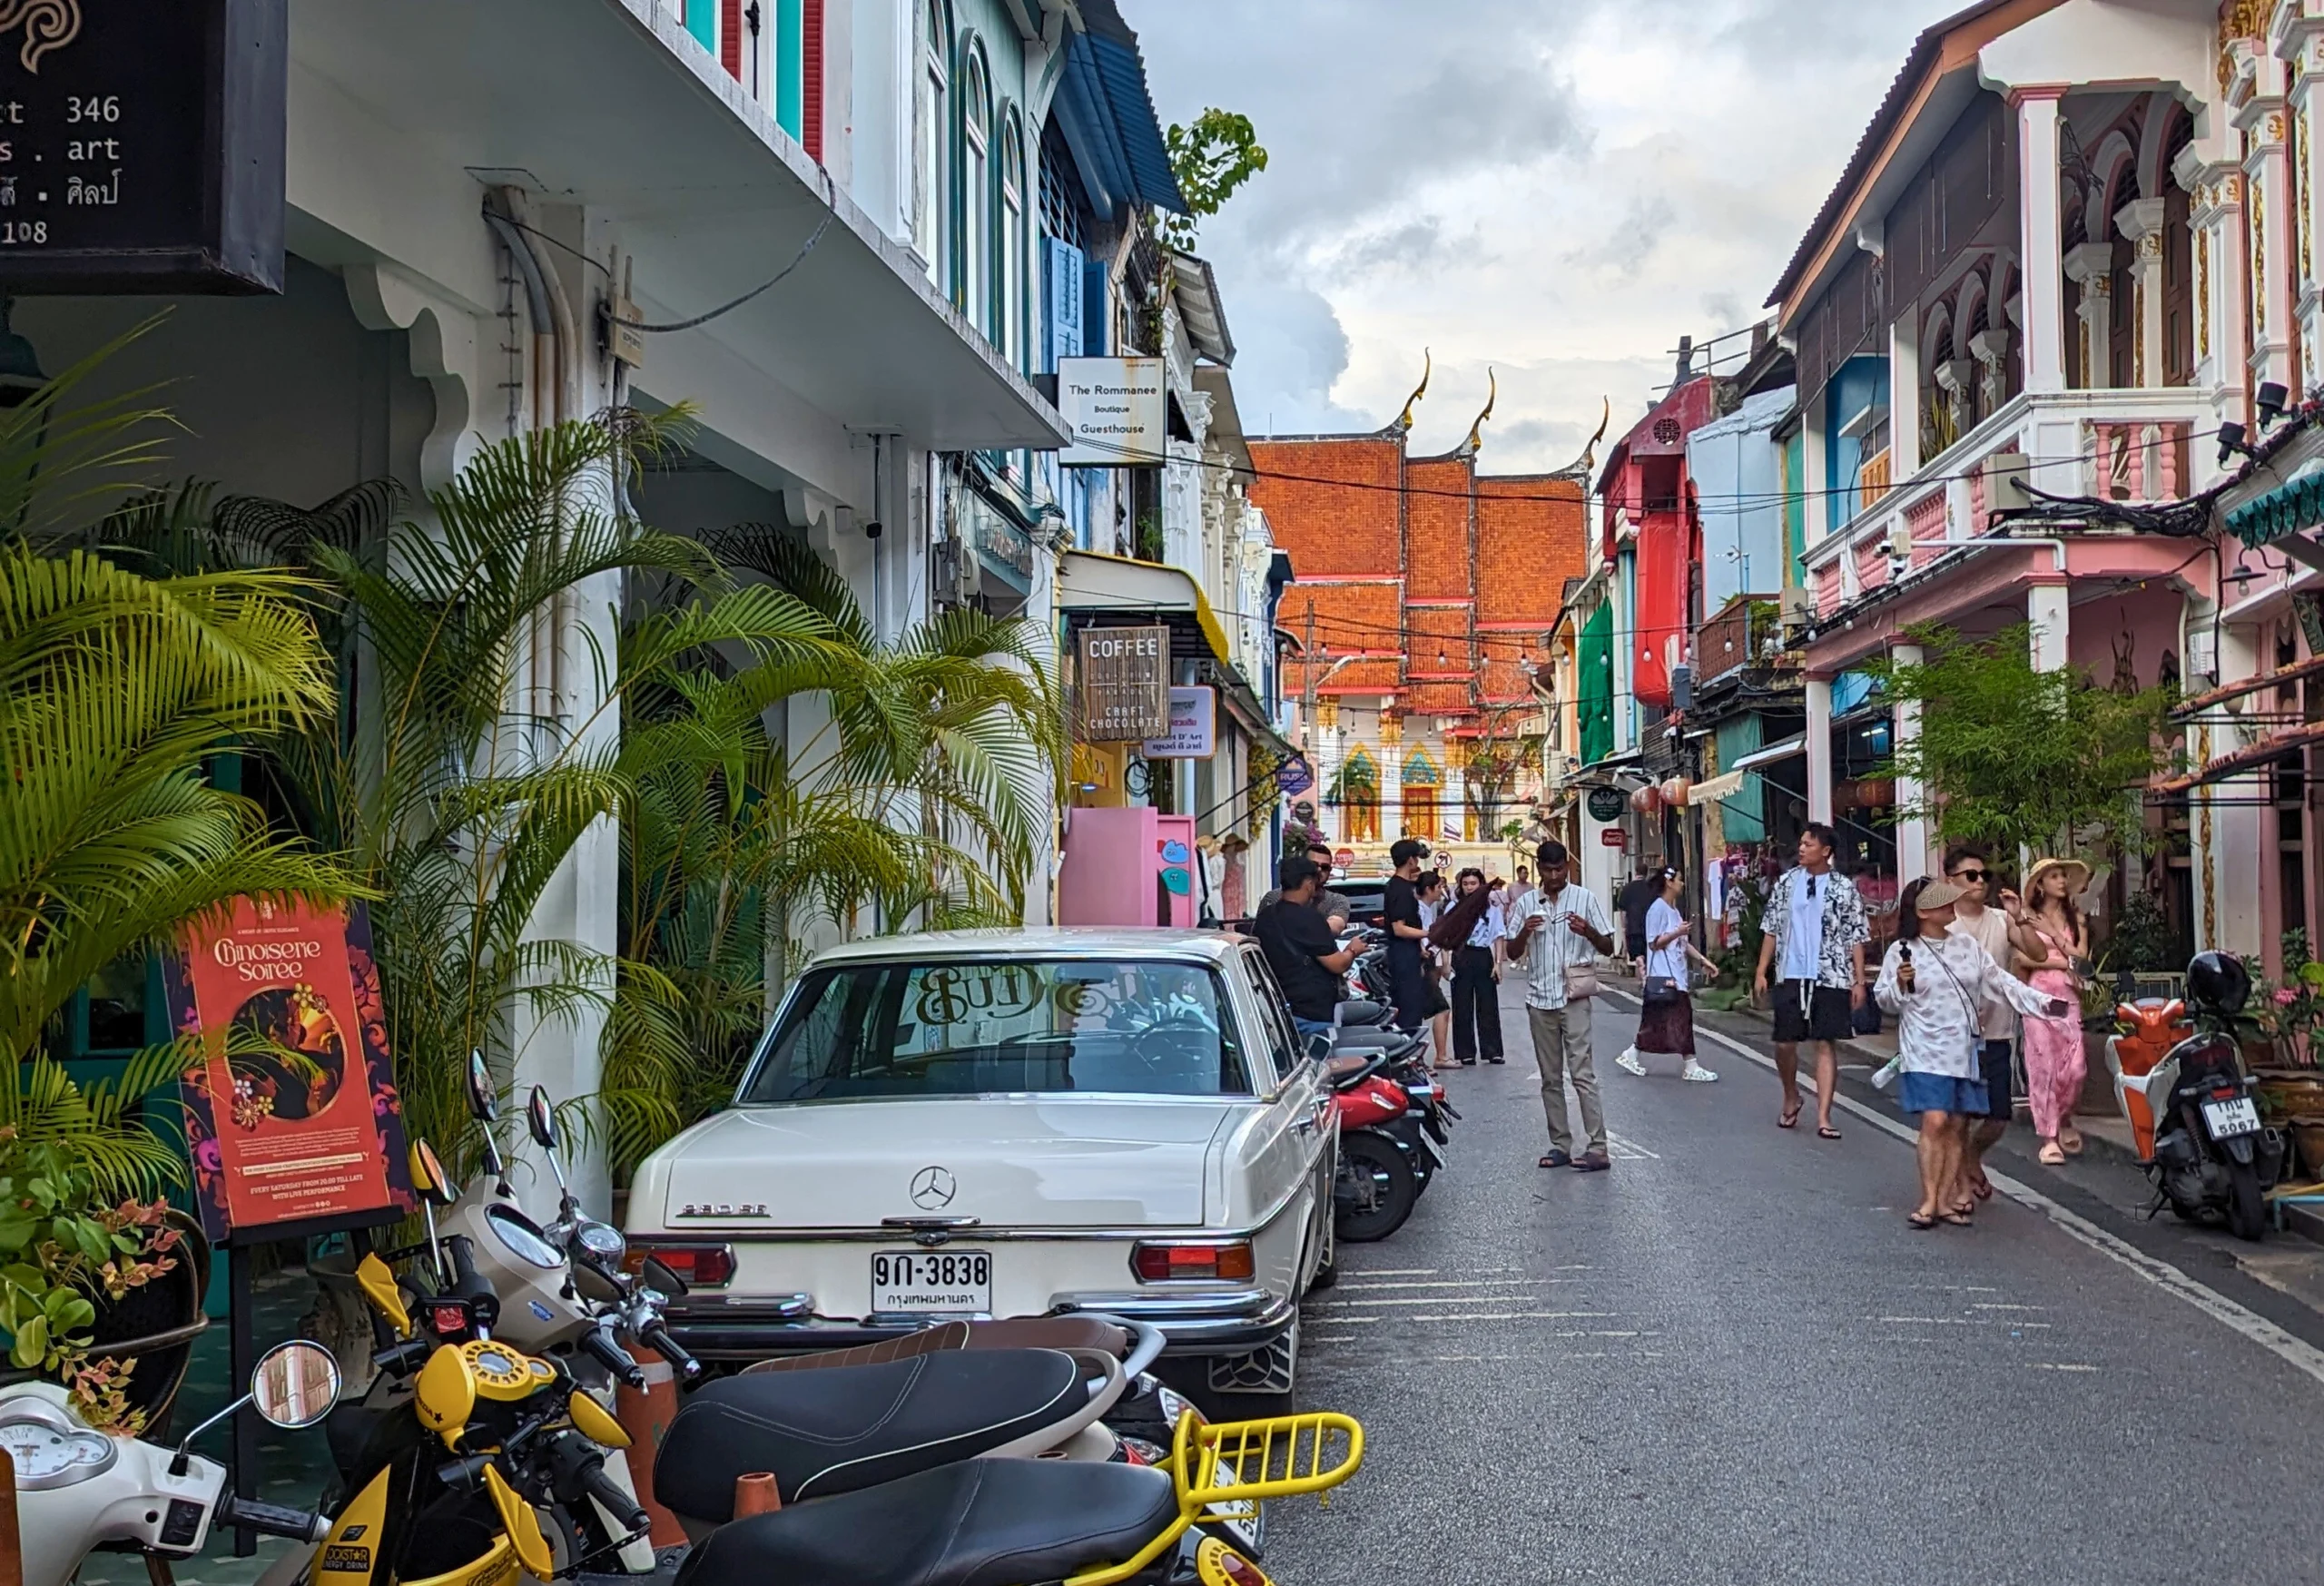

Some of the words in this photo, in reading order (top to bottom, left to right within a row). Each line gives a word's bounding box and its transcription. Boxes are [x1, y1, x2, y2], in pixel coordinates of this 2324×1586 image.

[66, 95, 121, 123] 346
[68, 137, 120, 161] art
[67, 168, 123, 205] ศิลป์
[2, 221, 47, 243] 108
[1068, 385, 1090, 395] The
[1094, 385, 1157, 395] Rommanee
[1094, 406, 1130, 414] Boutique
[1080, 424, 1145, 434] Guesthouse
[1089, 638, 1157, 657] COFFEE
[1106, 705, 1145, 717] CRAFT
[1090, 717, 1160, 729] CHOCOLATE
[214, 938, 321, 967] Chinoiserie
[875, 1256, 988, 1286] 9ก-3838
[887, 1294, 976, 1308] กรุงเทพมหานคร
[346, 1561, 369, 1570] DRINK
